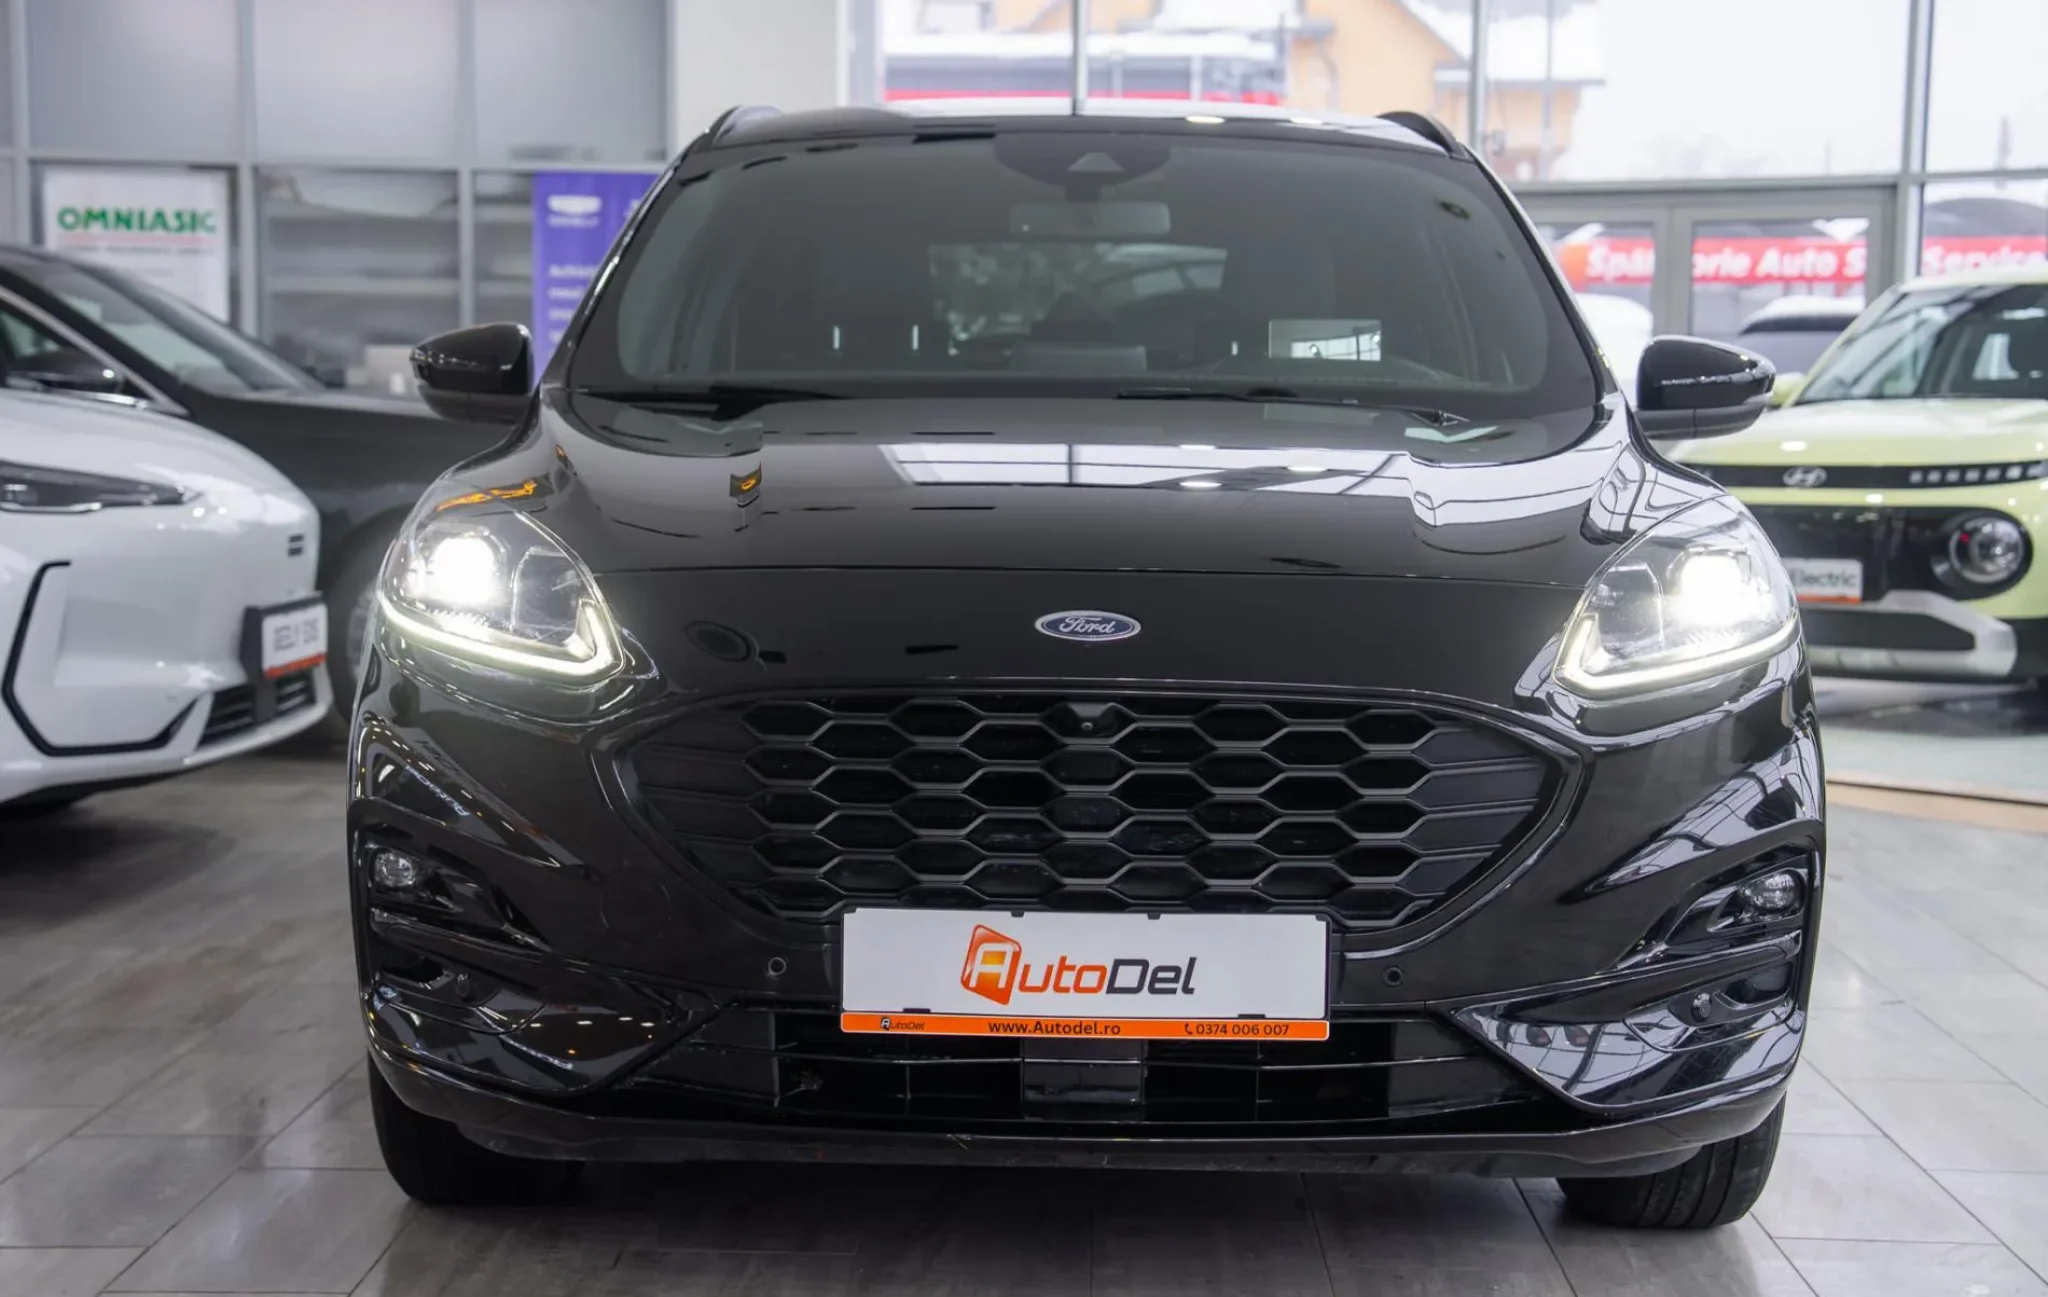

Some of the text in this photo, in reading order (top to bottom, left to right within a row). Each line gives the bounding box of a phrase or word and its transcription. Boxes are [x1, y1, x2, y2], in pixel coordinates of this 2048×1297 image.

[1755, 246, 1838, 277] Auto
[1058, 616, 1117, 634] Ford
[966, 939, 1198, 996] AutoDel
[988, 1021, 1121, 1035] www.Autodel.ro
[1195, 1023, 1290, 1036] 0374 006 007
